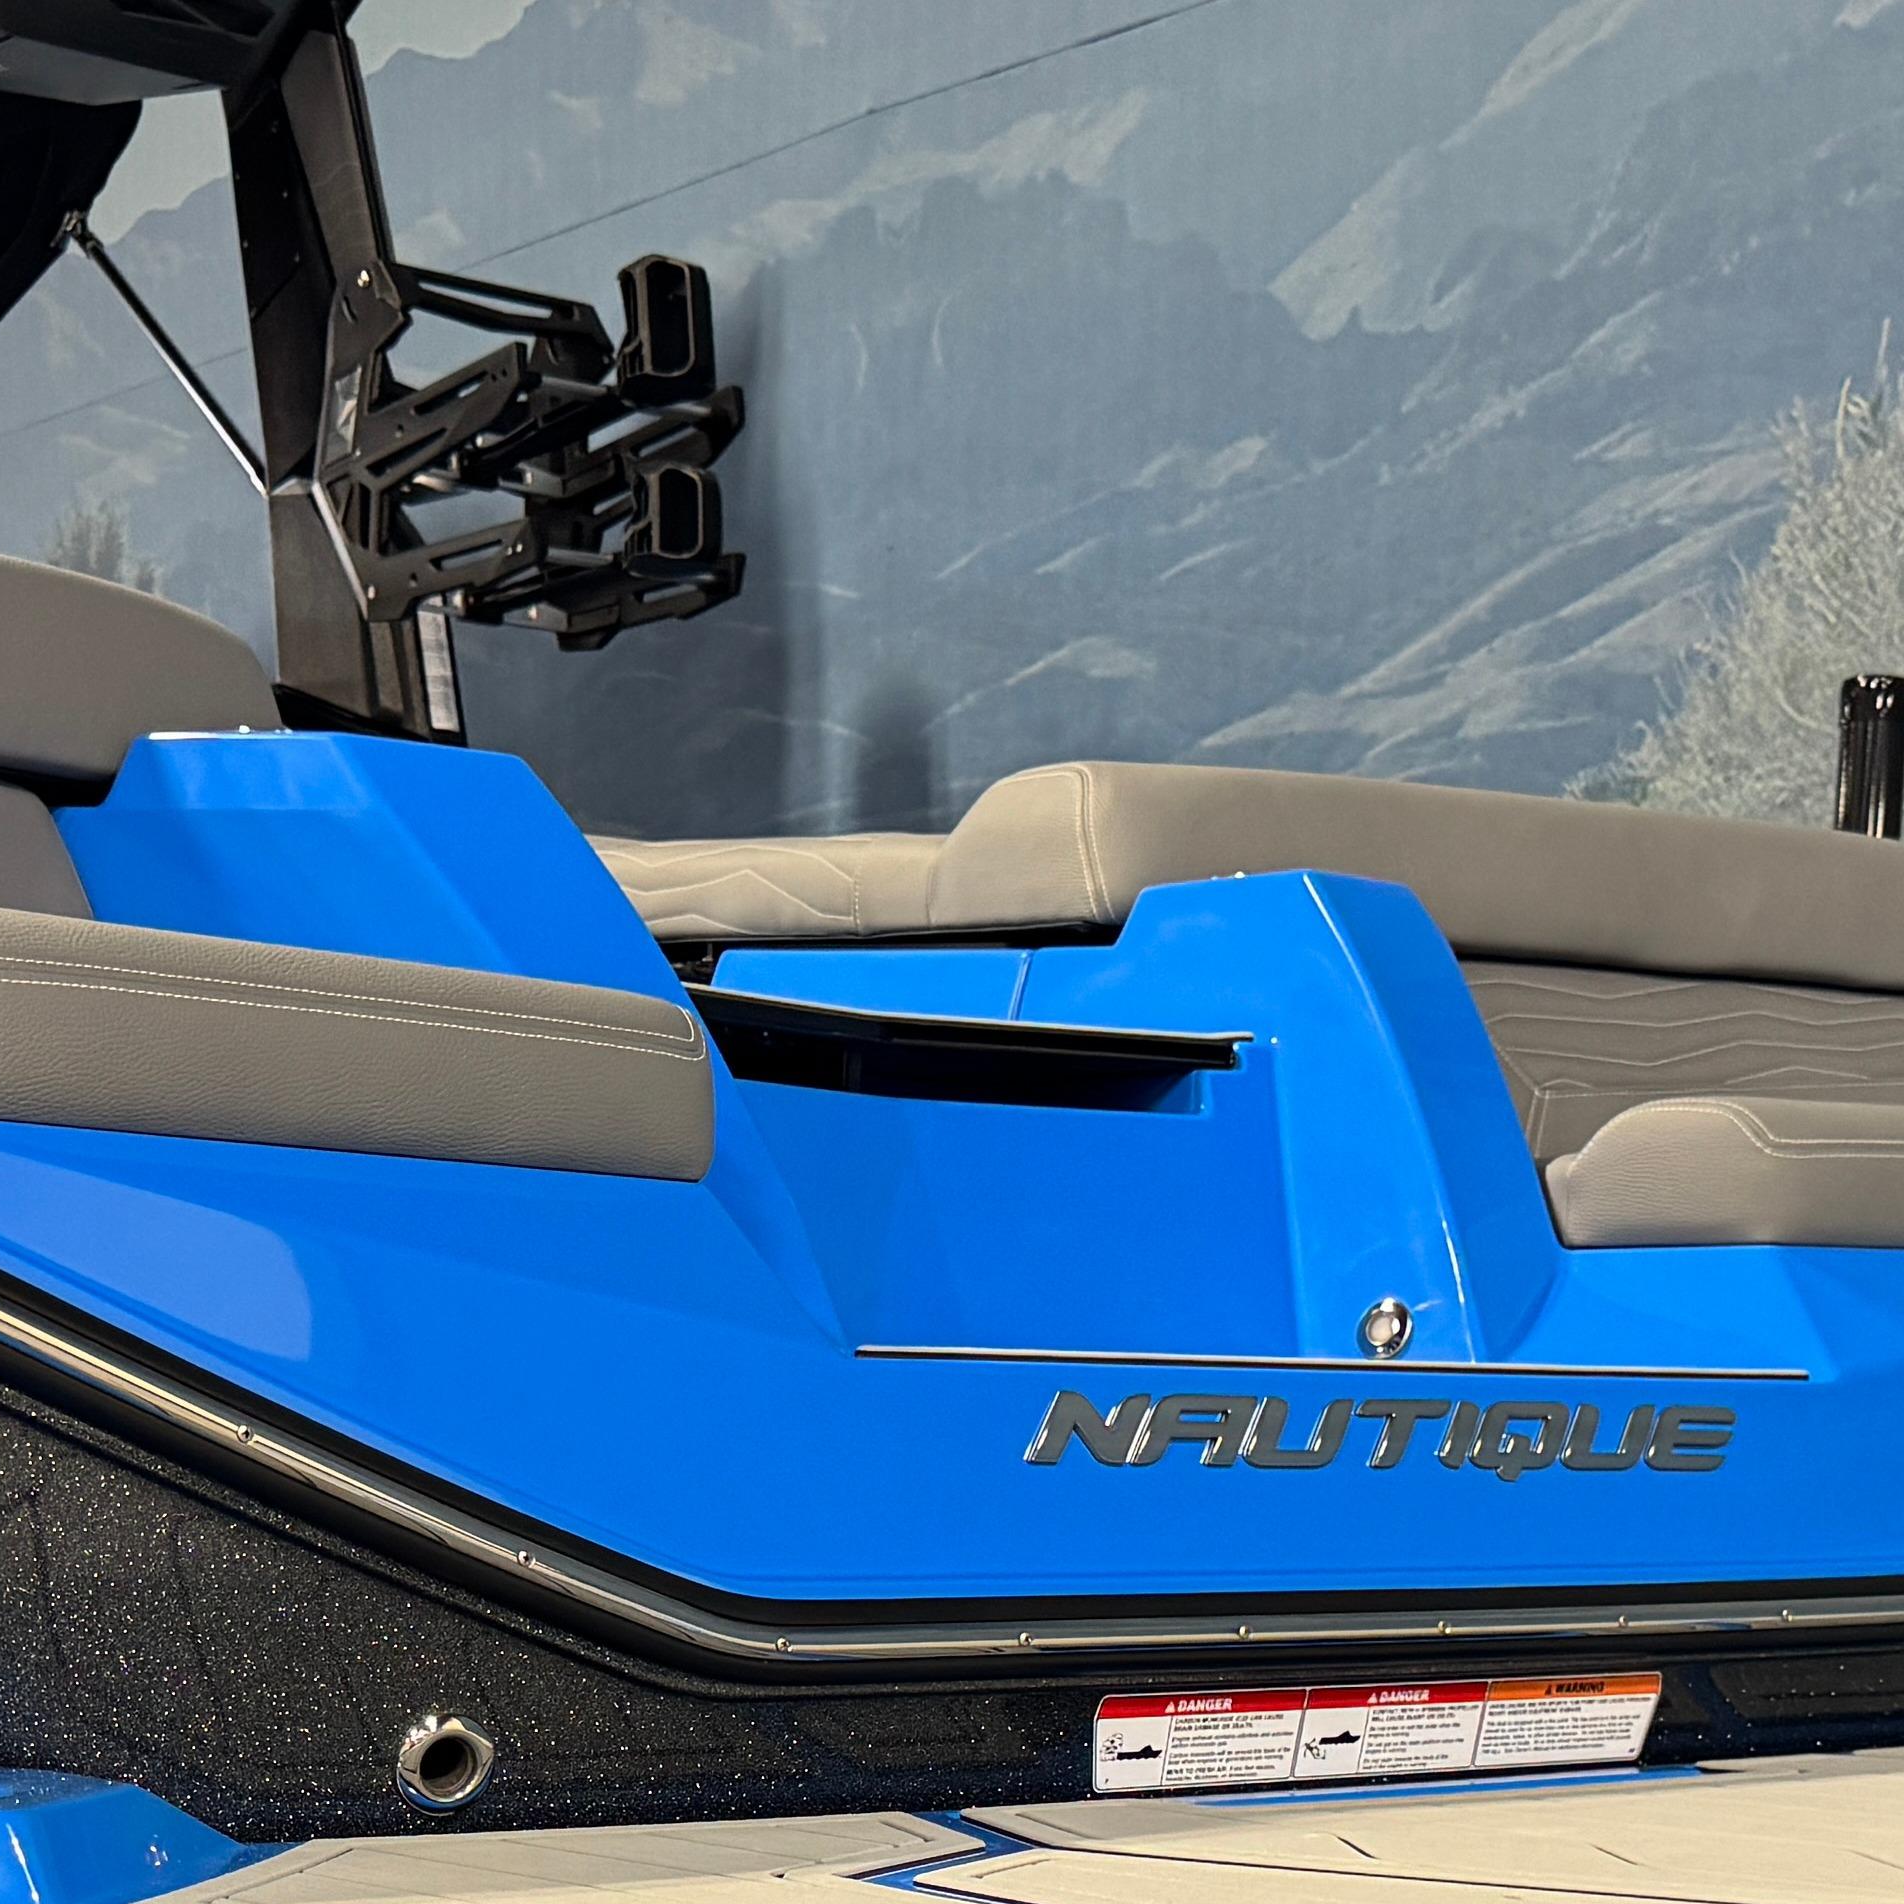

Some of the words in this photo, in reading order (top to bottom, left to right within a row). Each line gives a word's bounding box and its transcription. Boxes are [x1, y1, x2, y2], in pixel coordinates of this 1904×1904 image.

[1023, 1389, 1737, 1483] NAUTIQUE
[1379, 1689, 1431, 1704] DANGER
[1176, 1697, 1233, 1712] DANGER
